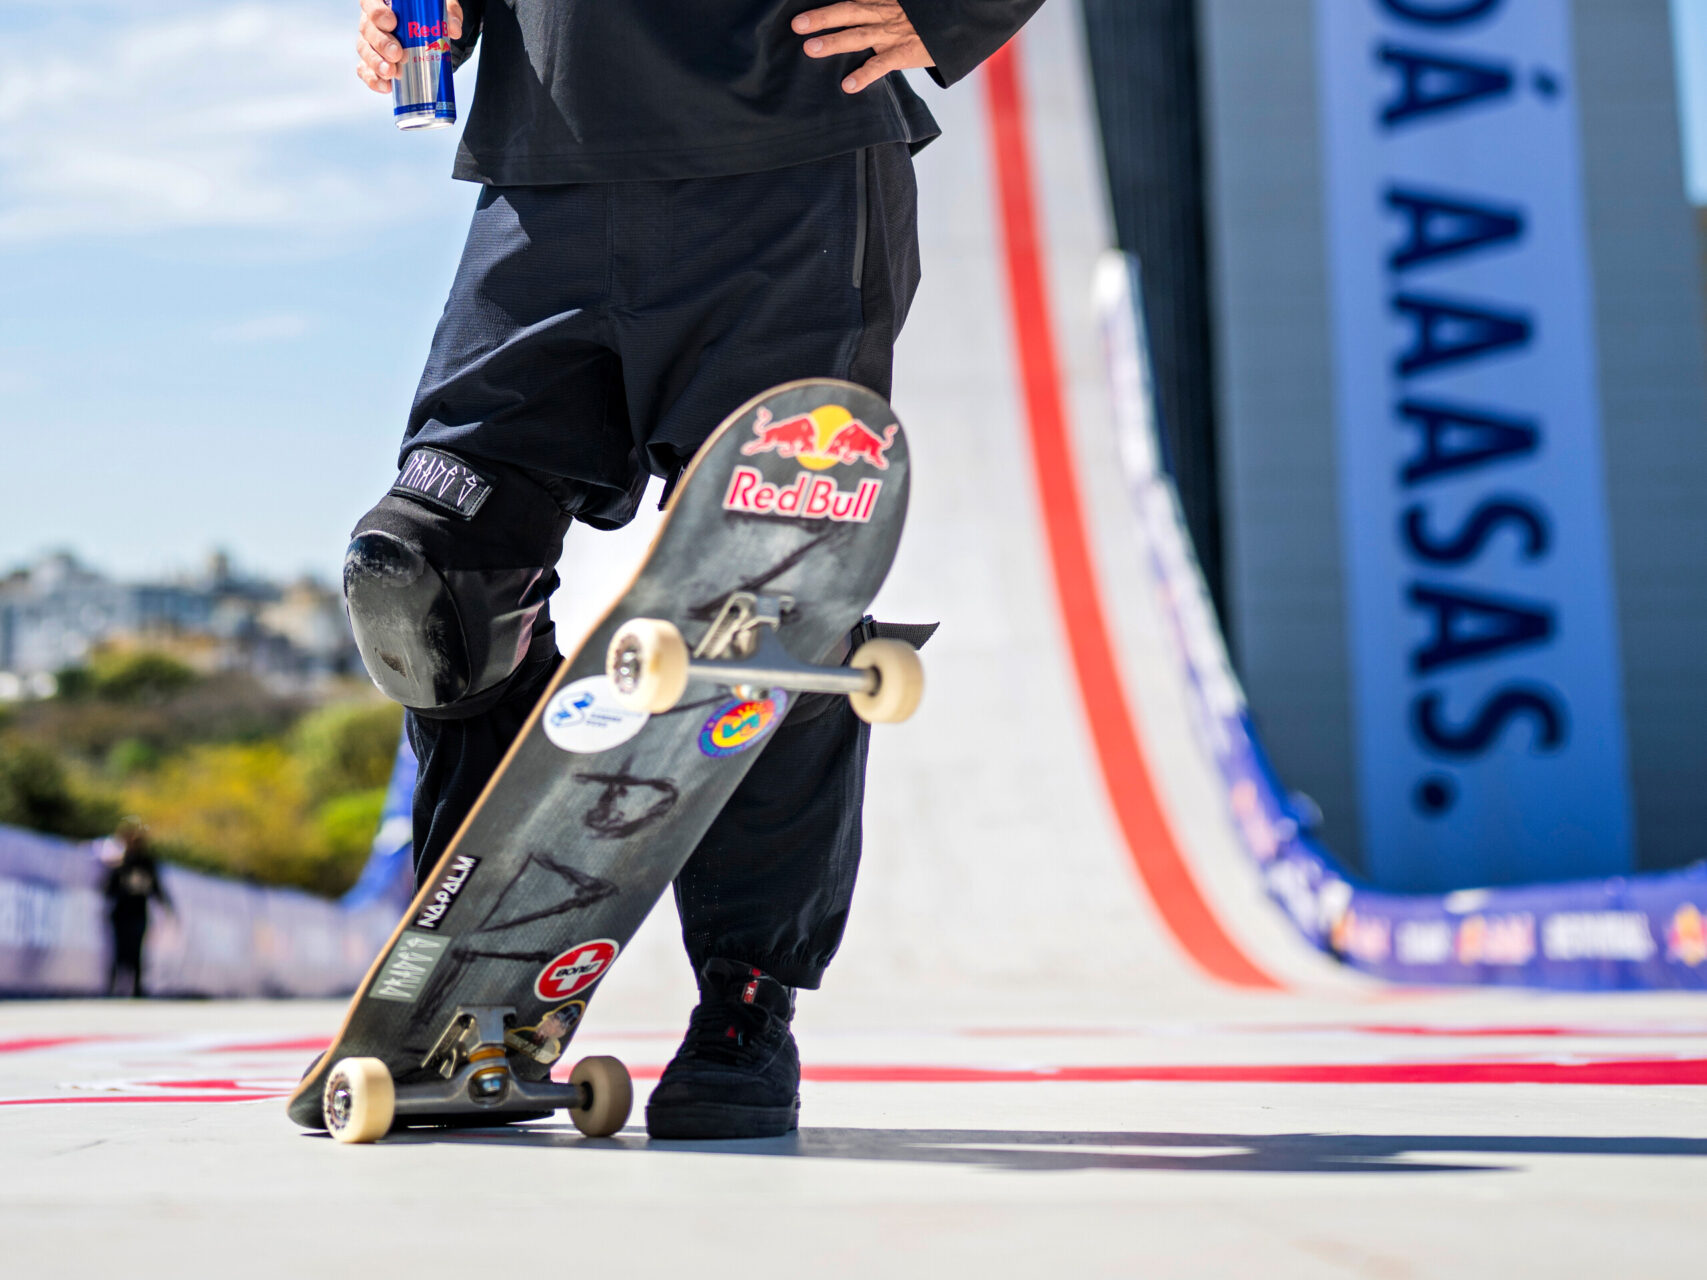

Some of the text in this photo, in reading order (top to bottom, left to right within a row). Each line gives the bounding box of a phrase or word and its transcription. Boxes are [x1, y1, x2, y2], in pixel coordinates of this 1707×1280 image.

[408, 19, 441, 38] Red
[728, 471, 878, 519] Red Bull
[1383, 184, 1569, 818] AAASAS.
